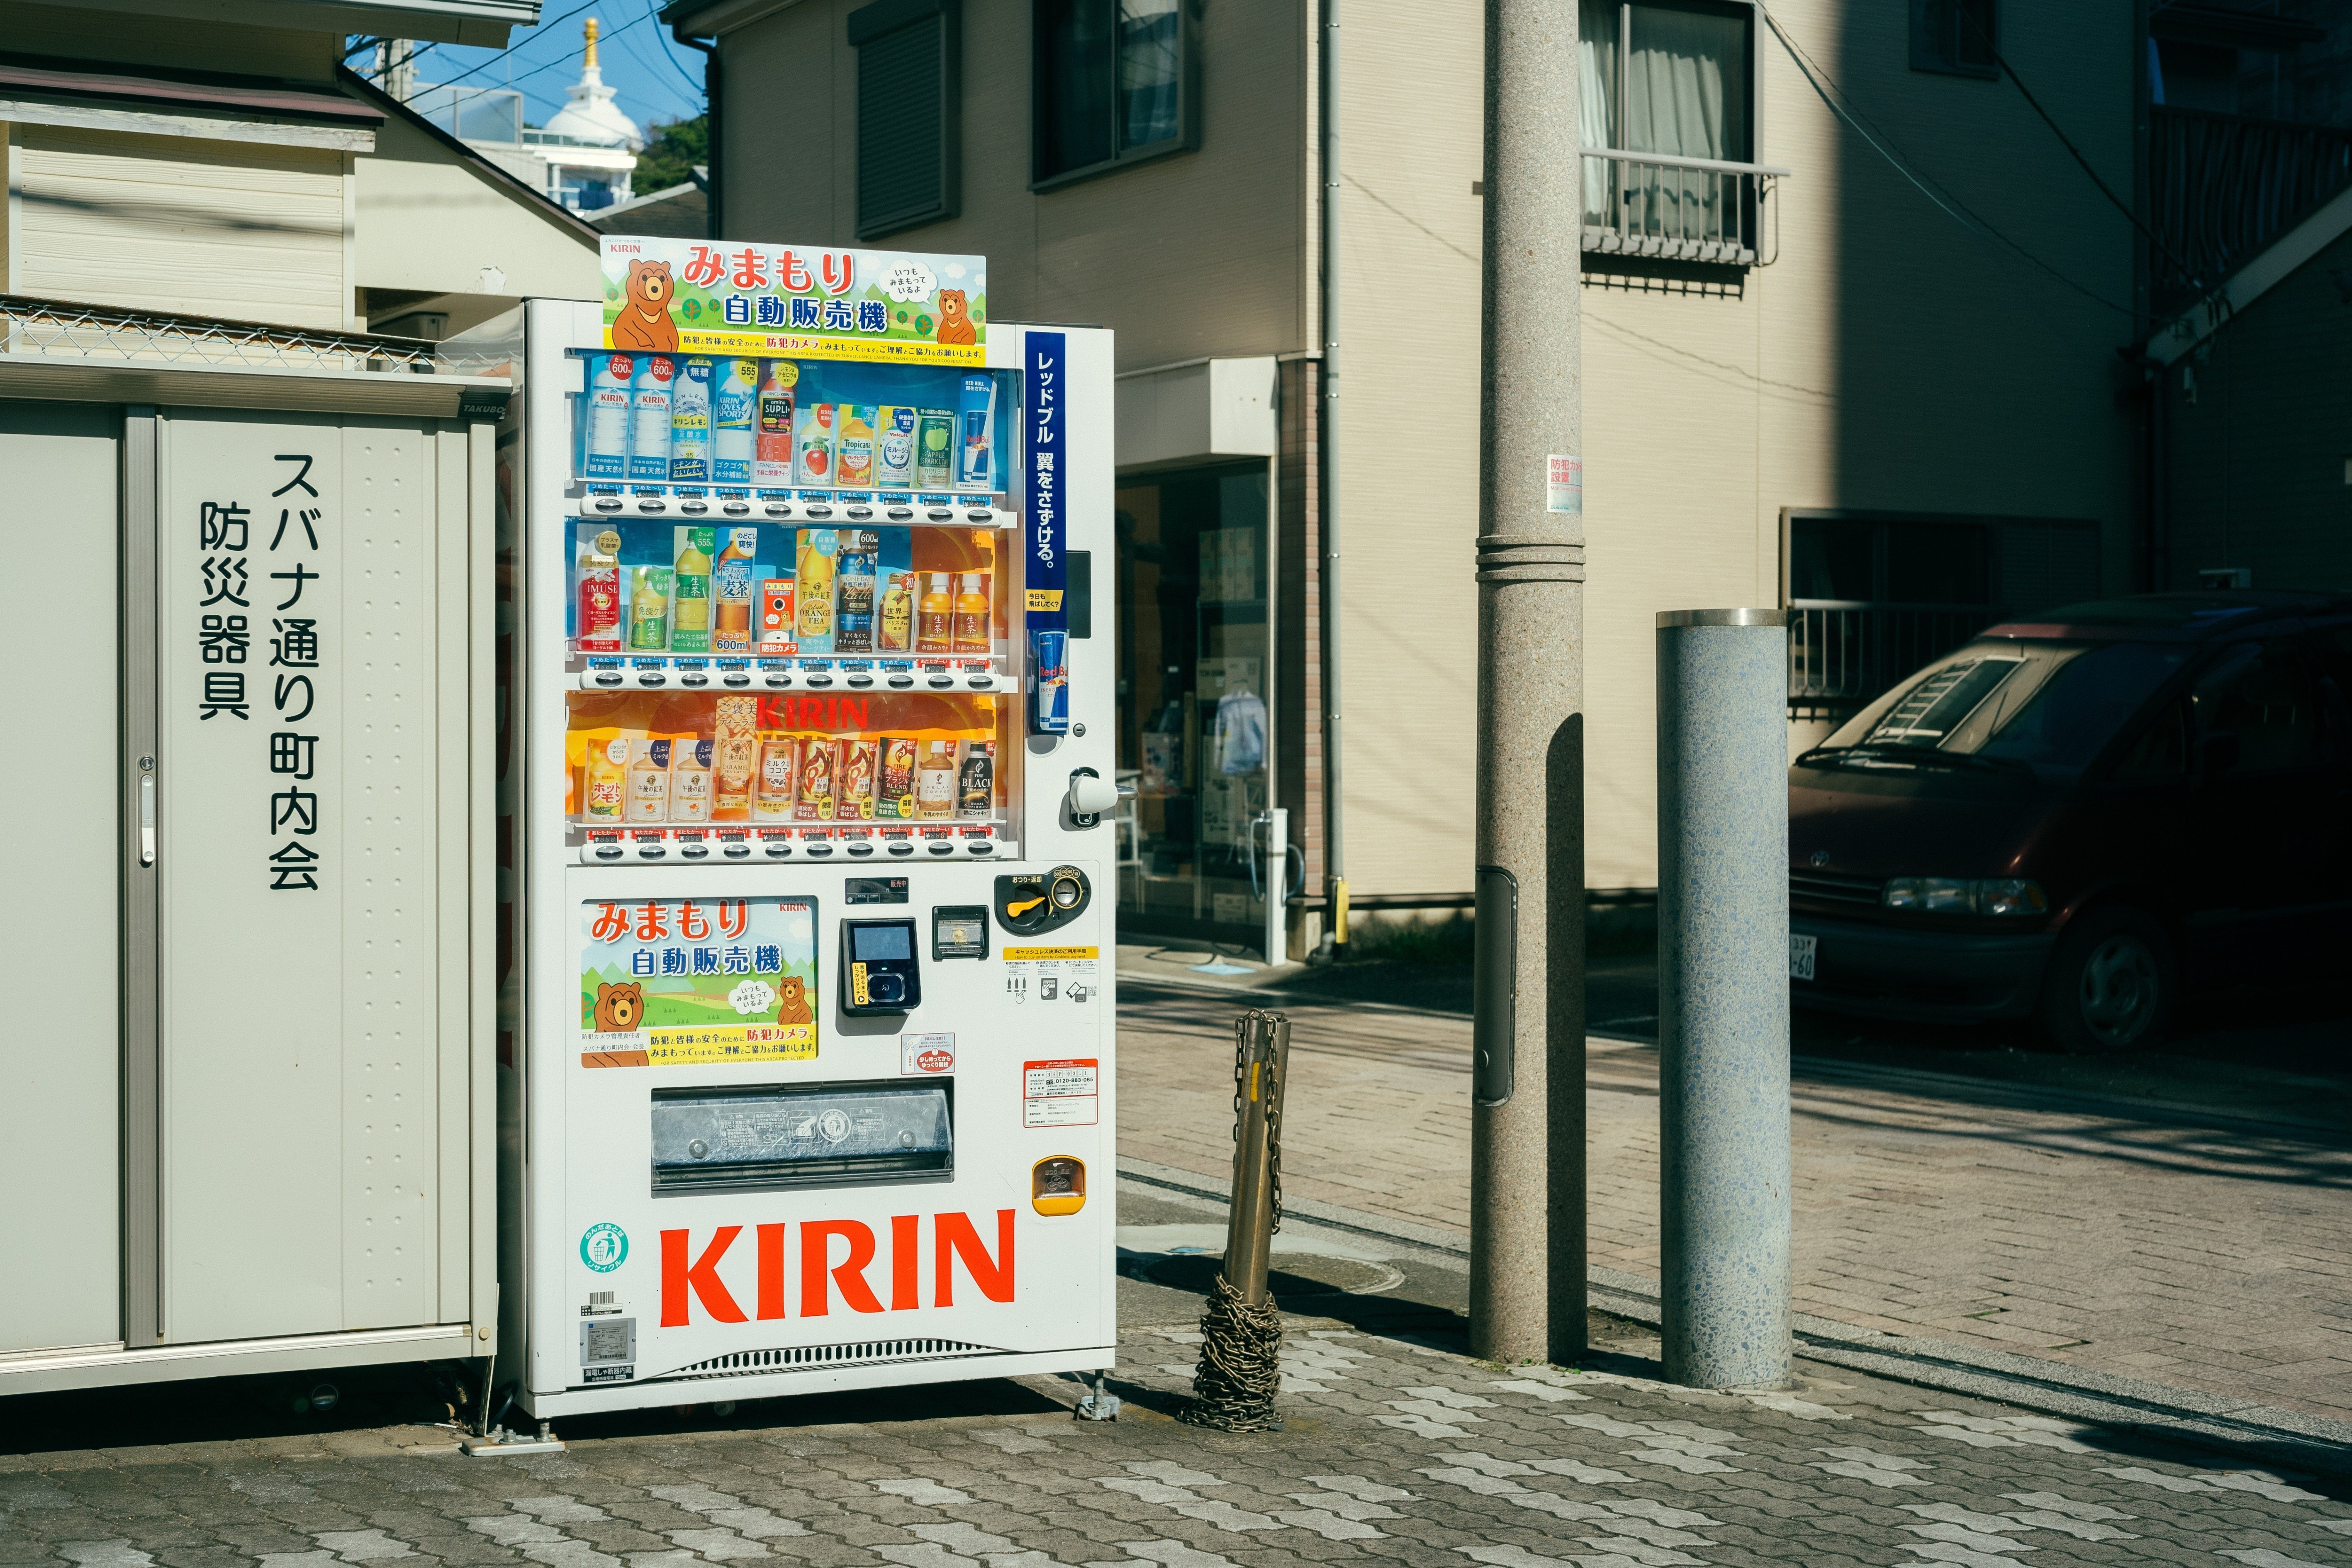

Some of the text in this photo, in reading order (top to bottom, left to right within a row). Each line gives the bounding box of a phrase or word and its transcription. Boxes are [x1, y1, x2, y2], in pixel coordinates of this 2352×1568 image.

[610, 244, 640, 253] KIRIN
[684, 246, 855, 294] みまもり
[895, 268, 918, 277] いつも
[890, 276, 927, 286] みまもって
[898, 285, 922, 295] いるよ
[726, 295, 887, 331] 自動販売機
[612, 363, 632, 374] 600ml
[653, 365, 672, 376] 600ml
[690, 367, 709, 377] 無糖
[741, 366, 755, 376] 555
[601, 394, 624, 402] KIRIN
[643, 396, 665, 404] KIRIN
[464, 404, 504, 414] TAKUBO
[679, 429, 701, 438] 炭酸水
[844, 439, 871, 449] Tropicana
[1037, 352, 1054, 569] レッドブル 翼をさずける。
[589, 464, 623, 474] 国産天然水
[632, 466, 665, 475] 国産天然水
[715, 470, 742, 479] 水分補給
[1551, 471, 1570, 483] 設置
[860, 533, 879, 543] 600ml
[690, 576, 700, 597] 生茶
[722, 580, 748, 597] 麦茶
[802, 591, 830, 599] 午後の紅茶
[199, 501, 251, 721] 防災器具
[638, 606, 664, 616] 免疫ケア
[799, 609, 830, 617] ORANGE
[934, 615, 943, 634] 生茶
[966, 615, 976, 634] 生茶
[647, 620, 657, 643] 生茶
[716, 639, 747, 651] 600ml
[761, 644, 797, 653] 防犯カメラ
[269, 454, 322, 891] スバナ通り町内会
[1040, 666, 1057, 676] Red
[719, 702, 757, 716] ご褒美
[756, 697, 868, 729] KIRIN
[719, 718, 757, 728] ティーラテ
[594, 782, 620, 793] ホット
[962, 778, 992, 788] BLACK
[638, 785, 663, 793] 午後の紅茶
[591, 792, 623, 803] レモン
[779, 903, 807, 912] KIRIN
[591, 899, 749, 942] みまもり
[631, 944, 782, 976] 自動販売機
[741, 985, 761, 993] いつも
[736, 991, 767, 1002] みまもって
[743, 999, 763, 1008] いるよ
[583, 1043, 644, 1052] スバナ通り町内会・会長
[585, 1223, 625, 1240] のんだあとは
[587, 1259, 622, 1273] リサイクル
[660, 1208, 1016, 1328] KIRIN
[585, 1366, 633, 1377] 漏電しゃ断器内蔵
